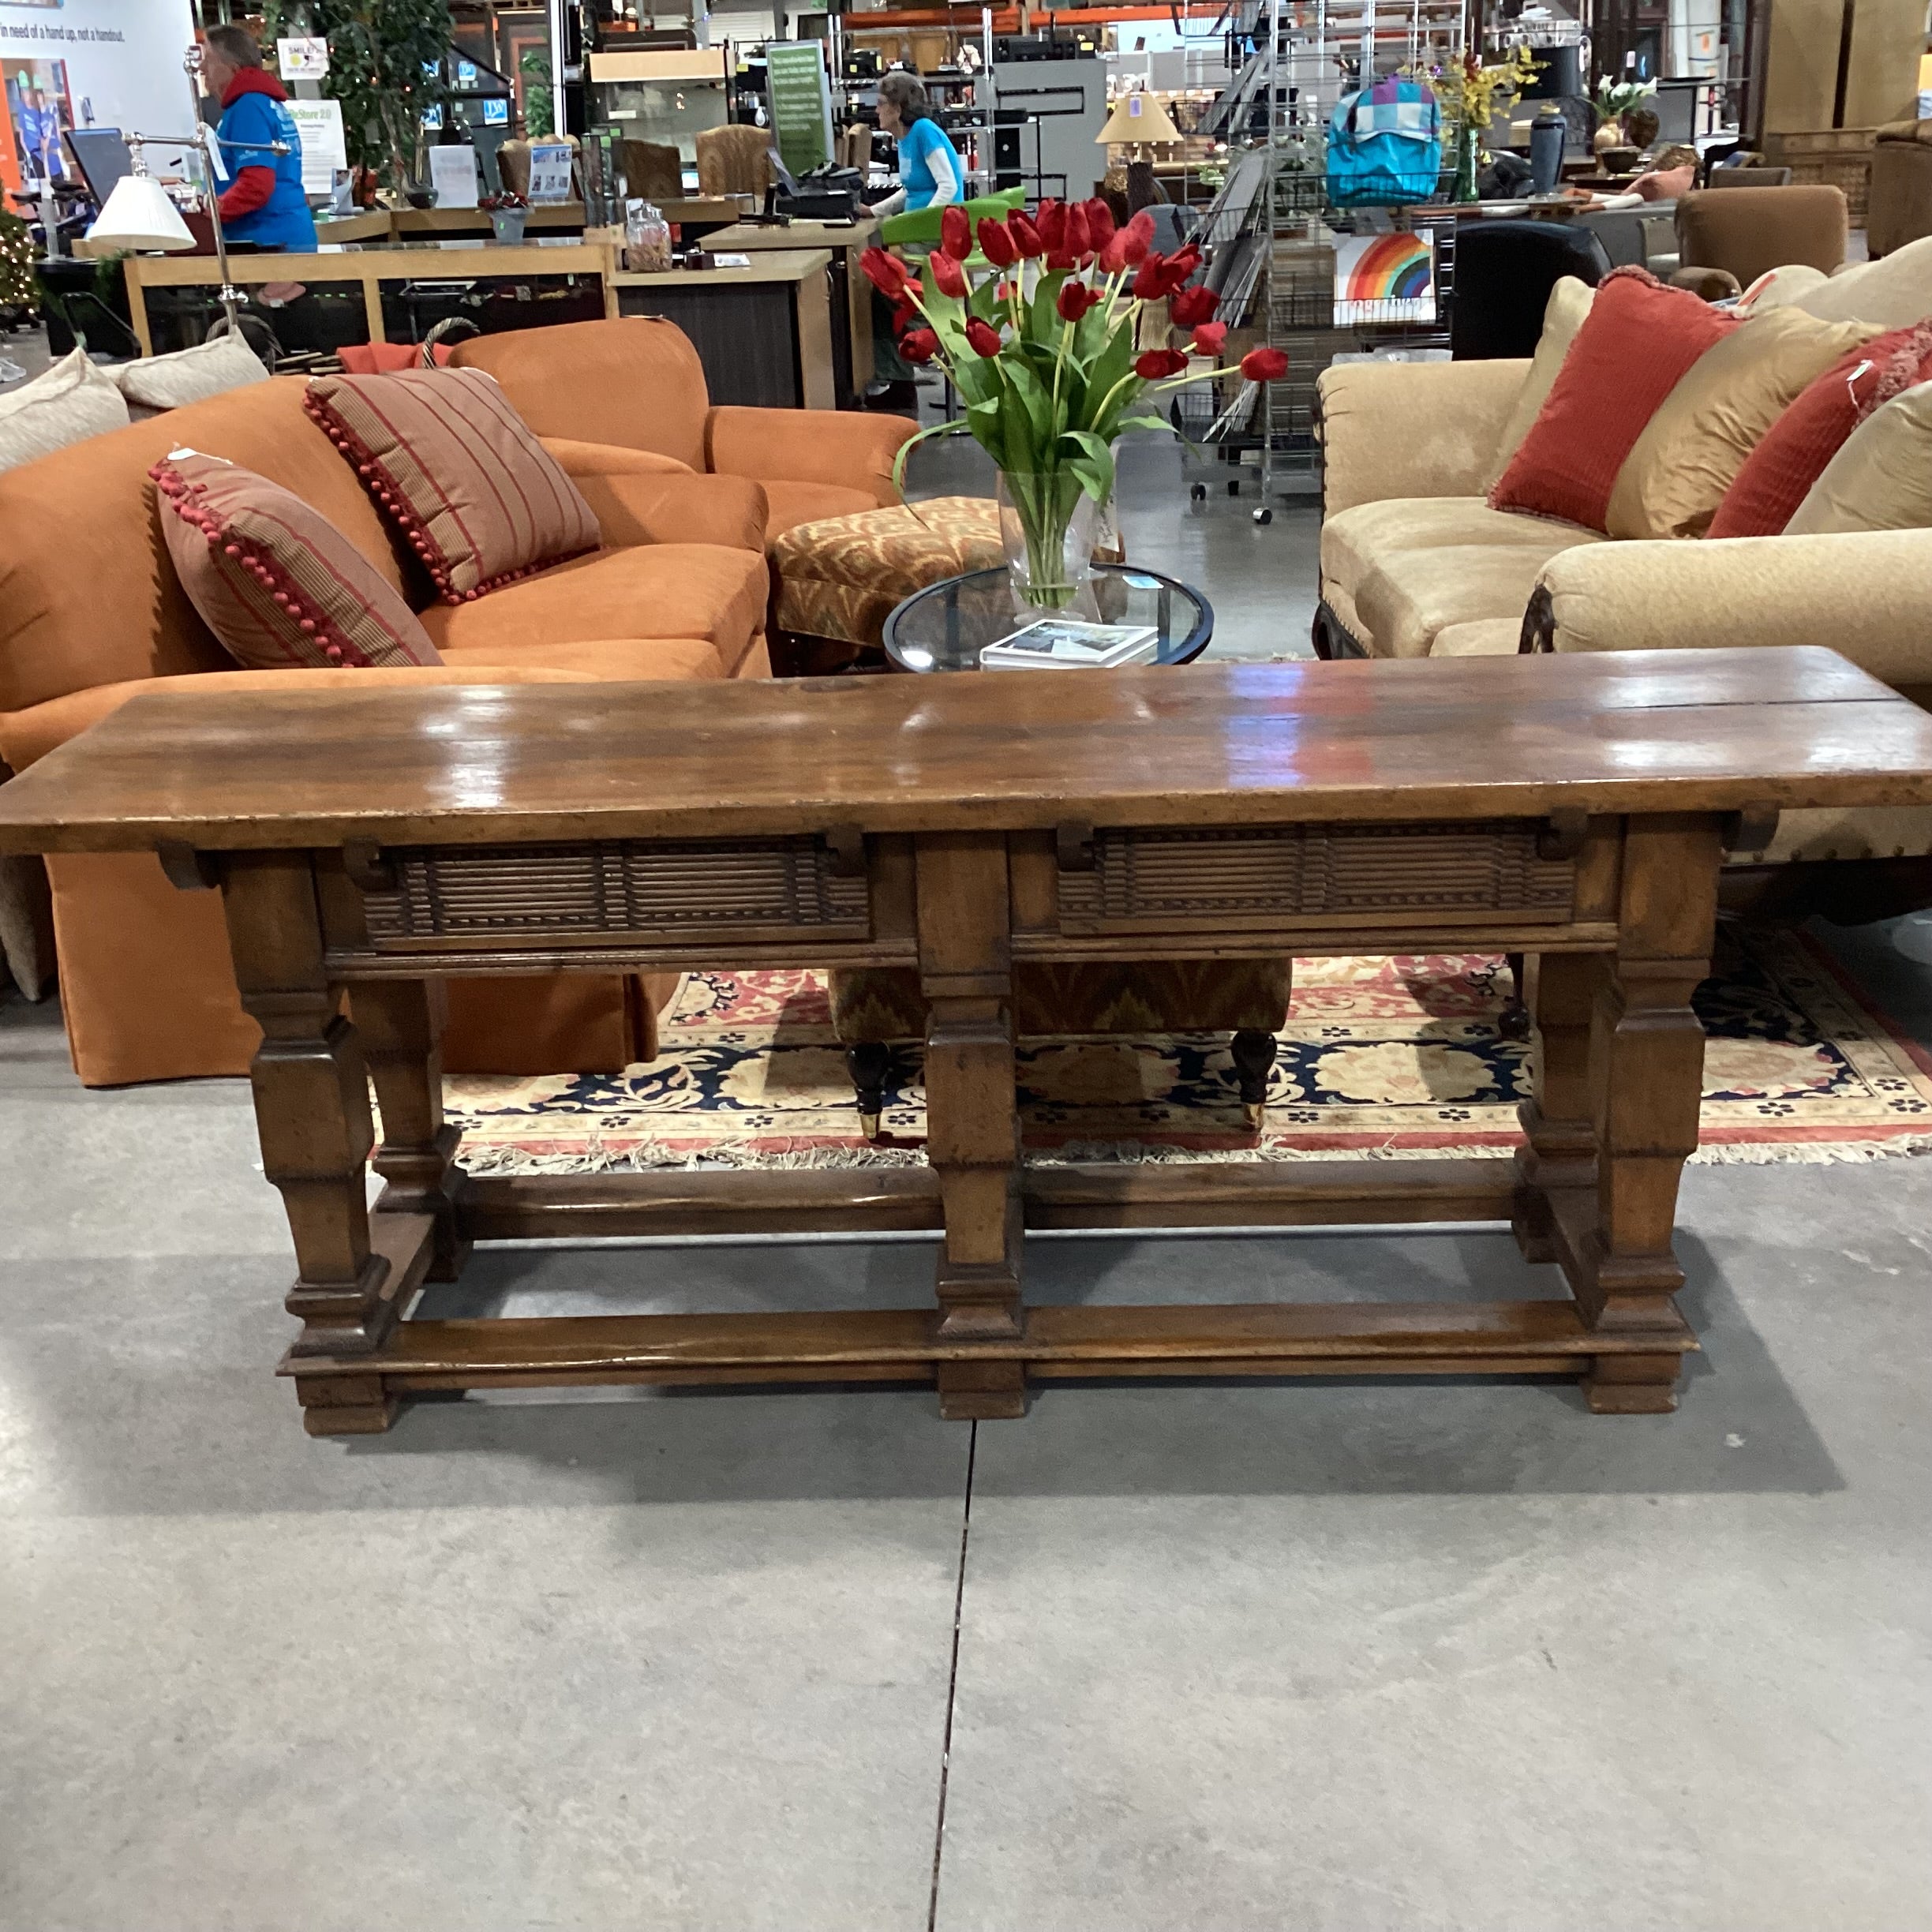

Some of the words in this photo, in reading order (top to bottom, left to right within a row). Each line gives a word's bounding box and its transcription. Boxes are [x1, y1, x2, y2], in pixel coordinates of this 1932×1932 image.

[9, 24, 29, 38] need
[30, 24, 38, 39] of
[39, 28, 45, 39] a
[45, 24, 64, 39] hand
[65, 28, 77, 43] up,
[77, 28, 90, 40] not
[91, 30, 95, 41] a
[95, 28, 125, 42] handout.
[320, 109, 331, 119] 2.0
